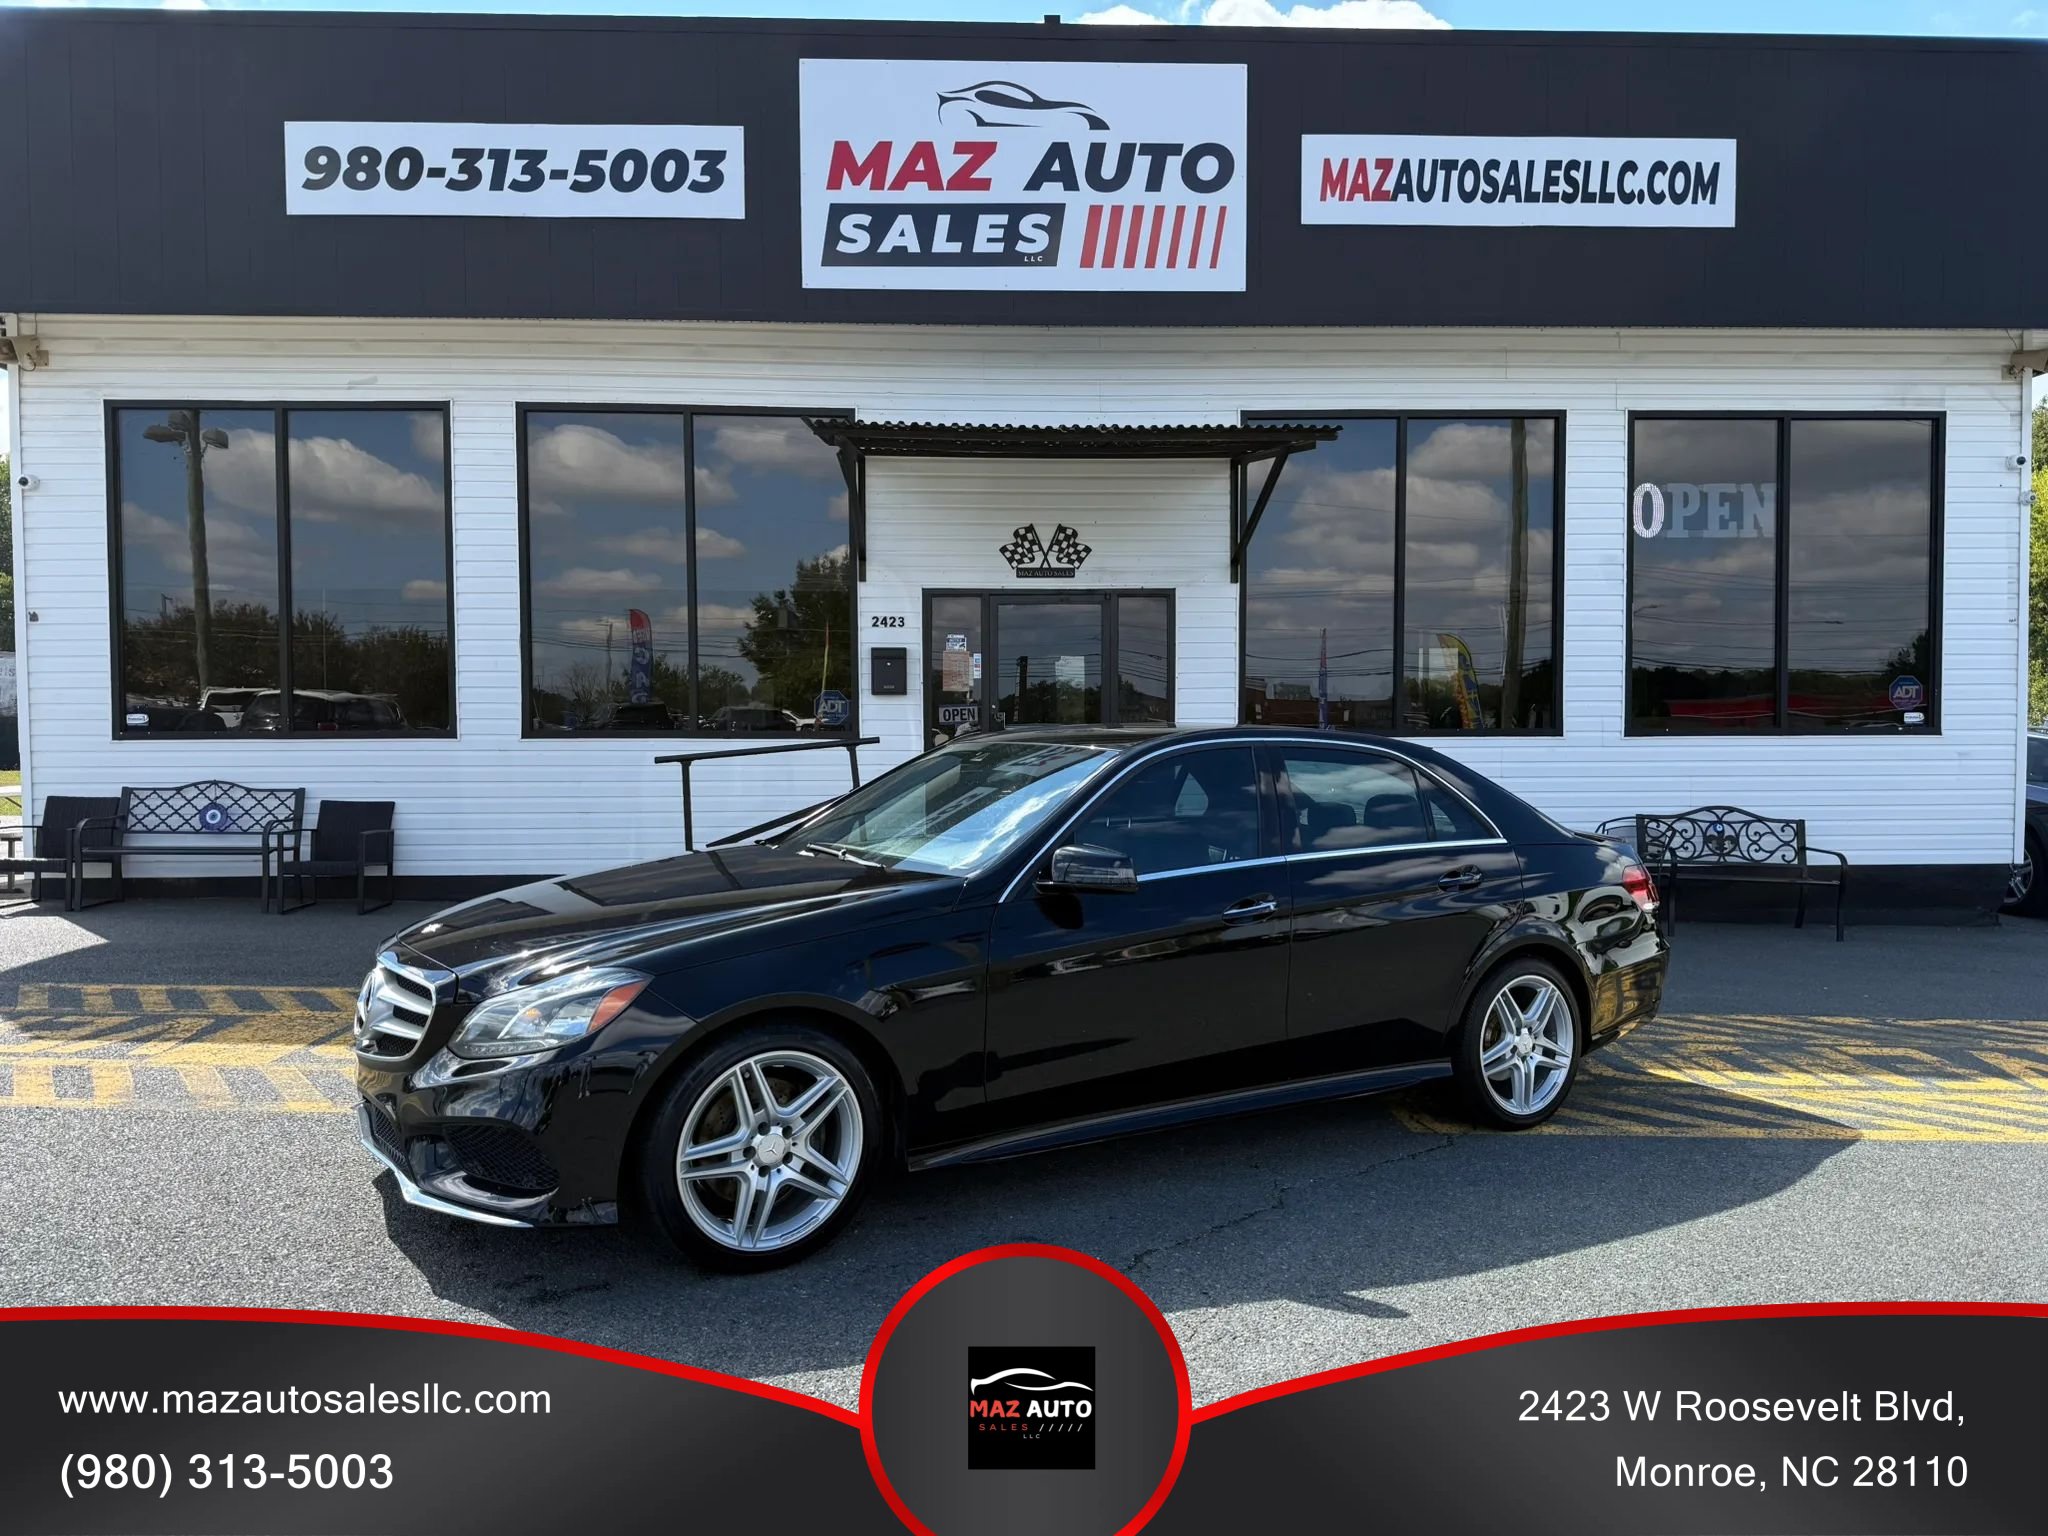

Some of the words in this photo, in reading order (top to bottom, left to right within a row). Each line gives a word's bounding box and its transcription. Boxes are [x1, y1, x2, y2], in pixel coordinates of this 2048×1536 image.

[302, 145, 727, 193] 980-313-5003
[826, 140, 998, 192] MAZ
[1022, 142, 1235, 194] AUTO
[1319, 157, 1721, 206] MAZAUTOSALESLLC.COM
[836, 213, 1052, 254] SALES
[1633, 482, 1776, 538] OPEN
[871, 616, 905, 628] 2423
[818, 700, 845, 713] ADT
[1893, 685, 1919, 698] ADT
[943, 708, 976, 722] OPEN
